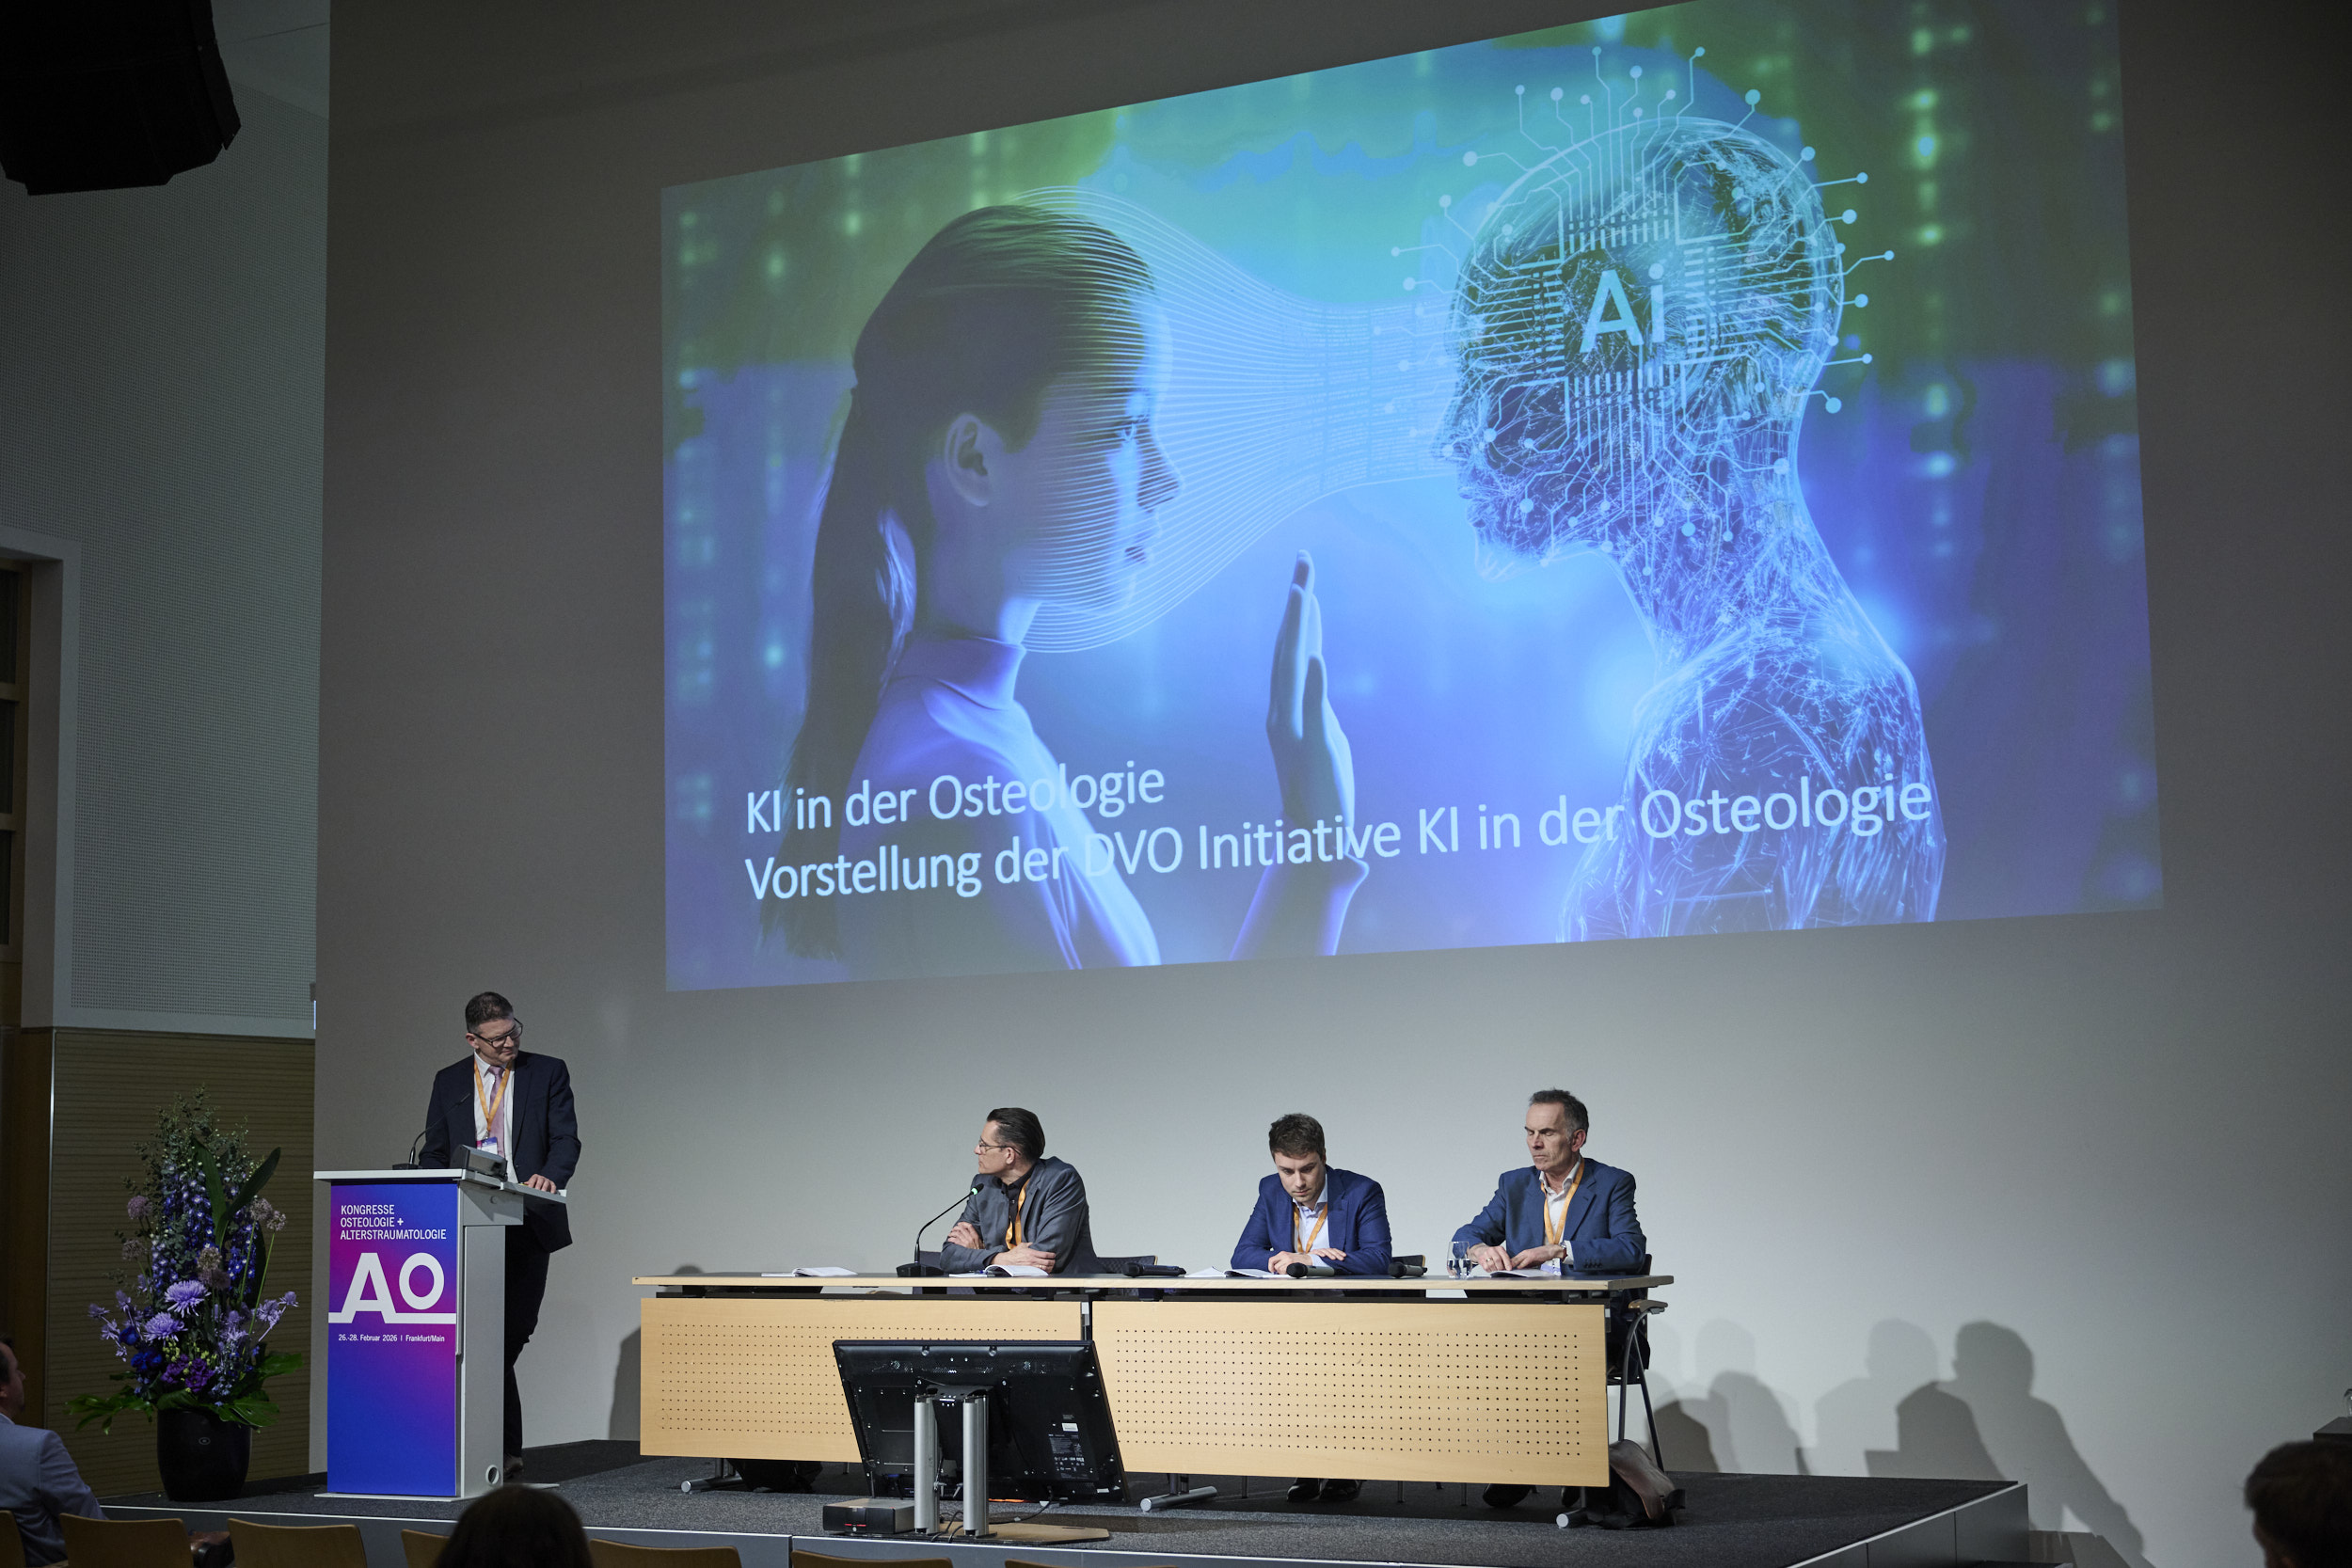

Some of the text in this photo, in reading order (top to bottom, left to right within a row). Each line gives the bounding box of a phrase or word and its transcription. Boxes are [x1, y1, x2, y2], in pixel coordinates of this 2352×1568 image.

[1580, 262, 1665, 353] Ai
[747, 760, 1165, 833] KI in der Osteologie
[744, 773, 1931, 898] Vorstellung der DVO Initiative KI in der Osteologie
[340, 1217, 395, 1227] OSTEOLOGIE
[340, 1229, 447, 1240] ALTERSTRAUMATOLOGIE
[341, 1204, 395, 1215] KONGRESSE
[340, 1252, 445, 1324] AO
